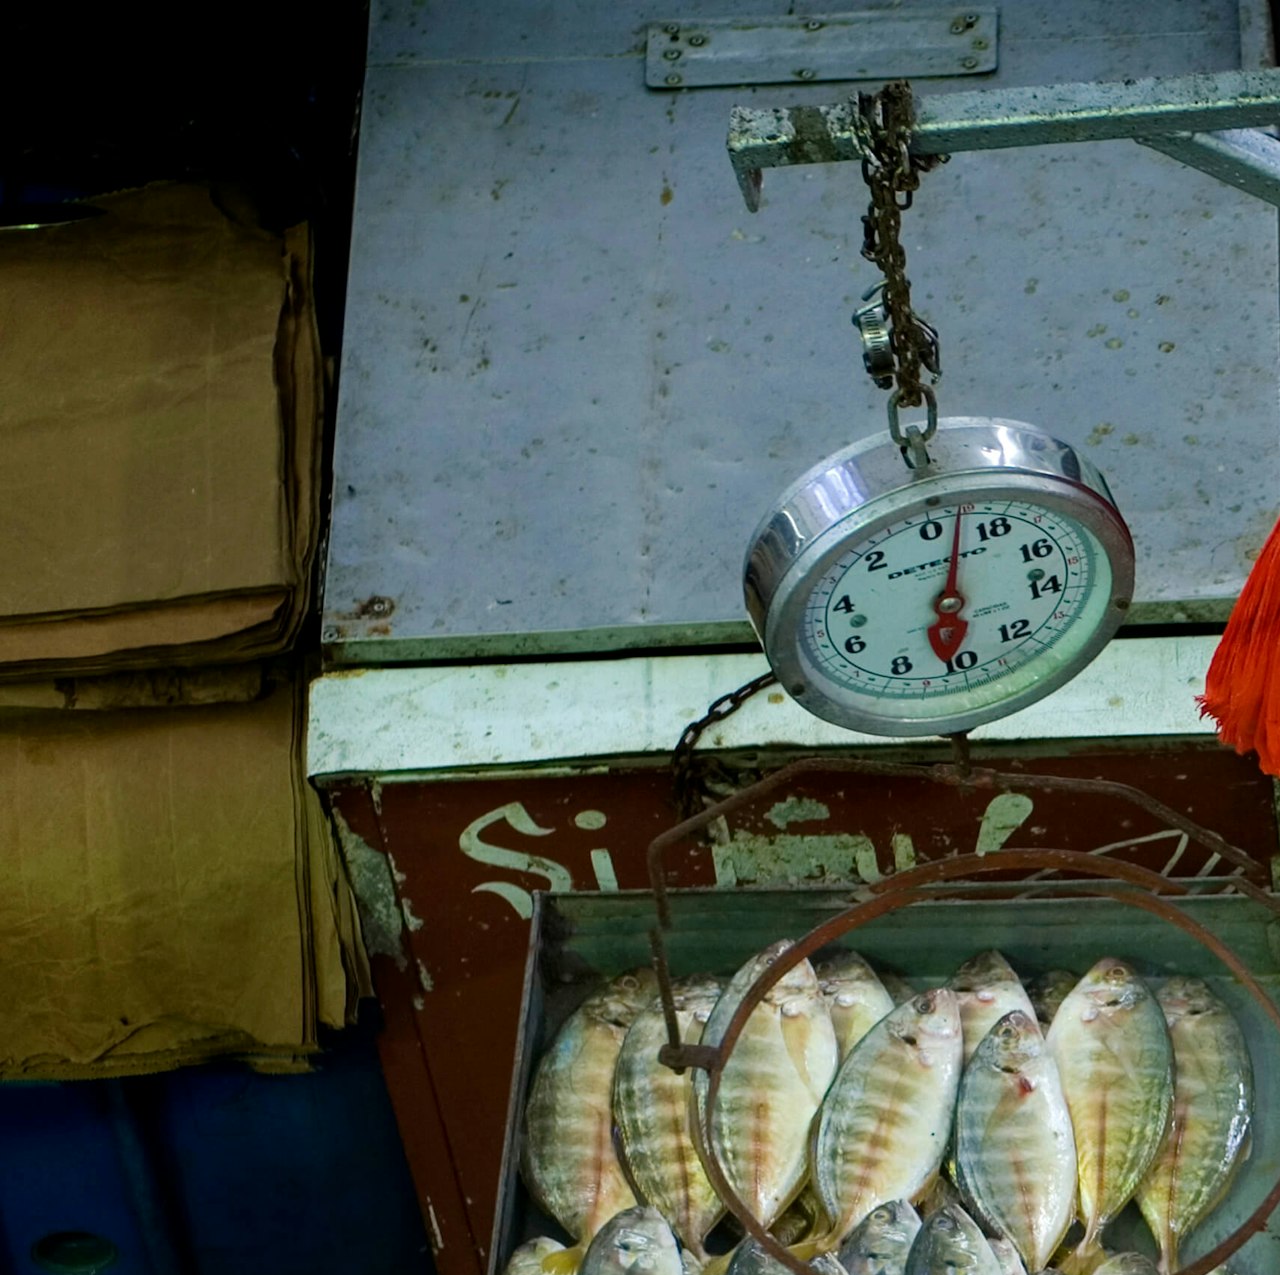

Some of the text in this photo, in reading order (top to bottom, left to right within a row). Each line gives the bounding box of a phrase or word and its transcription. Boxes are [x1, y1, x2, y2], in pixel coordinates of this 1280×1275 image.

[919, 520, 943, 541] 0
[976, 516, 1012, 542] 18
[864, 550, 888, 573] 2
[1019, 538, 1053, 564] 16
[1028, 574, 1063, 601] 14
[832, 594, 856, 615] 4
[997, 618, 1032, 644] 12
[844, 635, 867, 654] 6
[890, 655, 913, 676] 8
[947, 650, 978, 676] 10
[459, 801, 620, 919] Si
